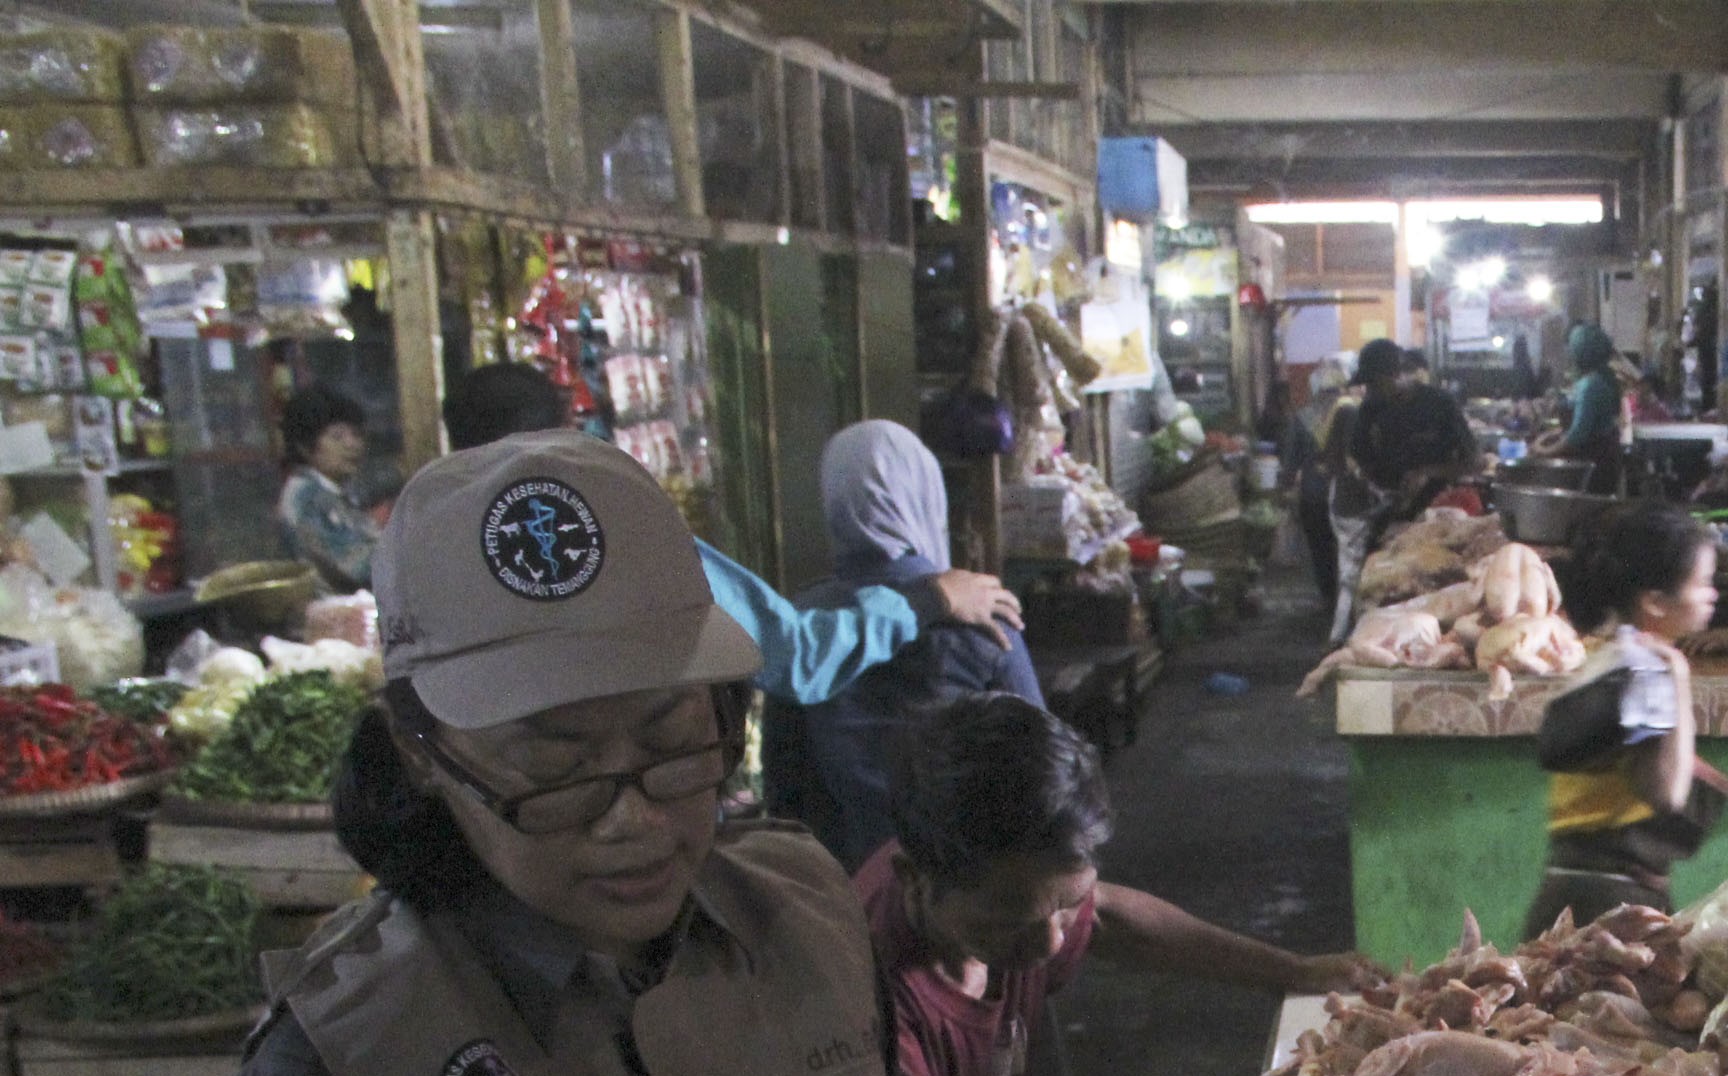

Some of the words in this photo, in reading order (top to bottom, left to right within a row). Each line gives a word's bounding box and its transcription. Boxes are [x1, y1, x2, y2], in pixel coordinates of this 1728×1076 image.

[485, 500, 509, 556] PETUGAS
[504, 482, 570, 506] KESEHATAN
[568, 496, 599, 535] HEWAN
